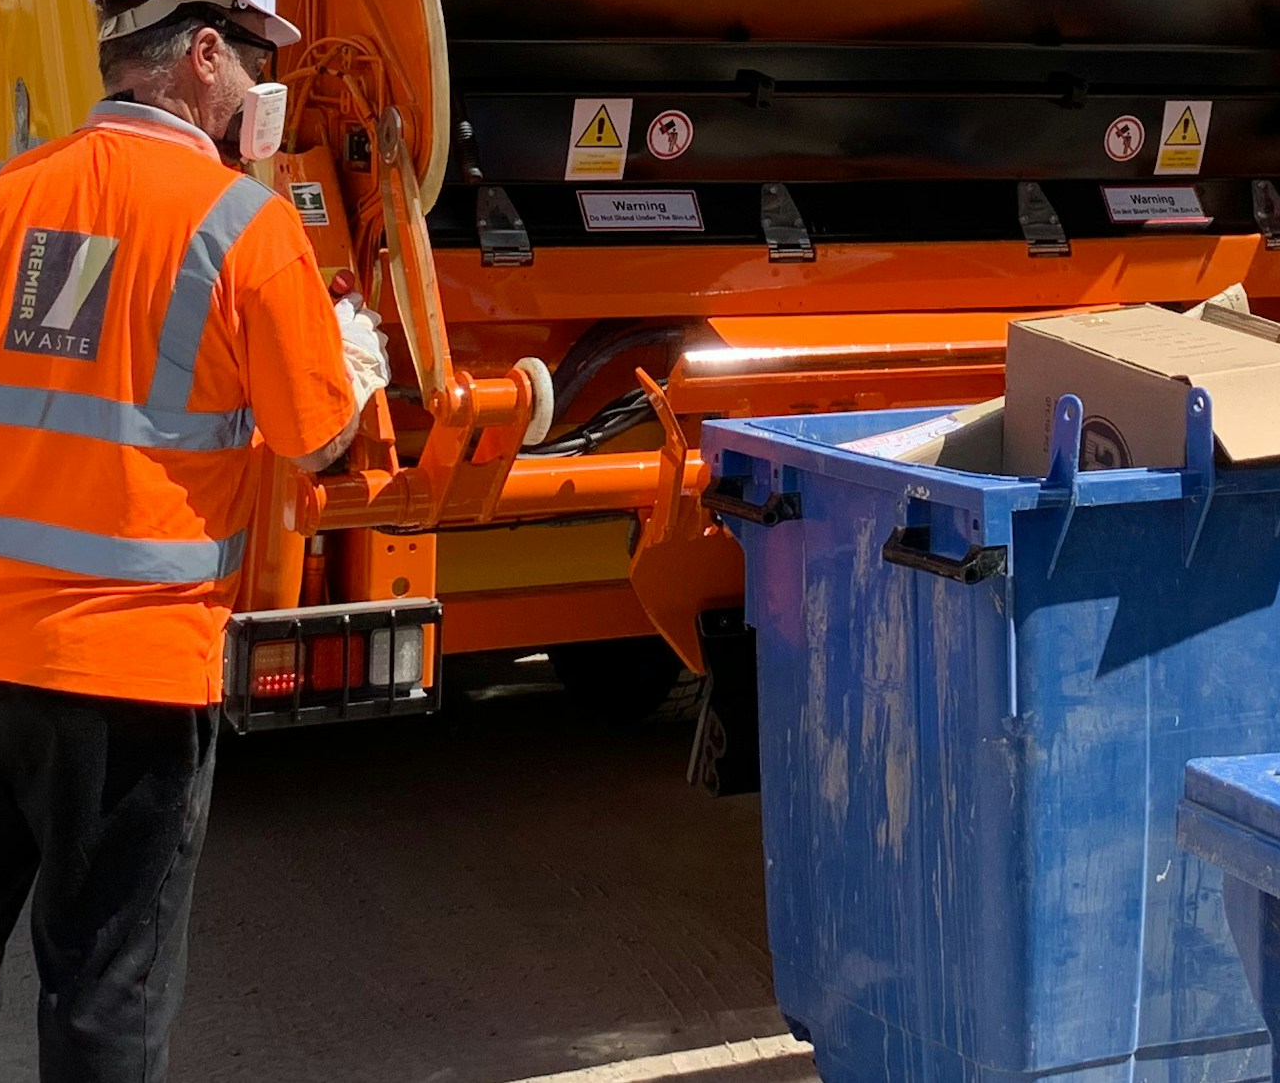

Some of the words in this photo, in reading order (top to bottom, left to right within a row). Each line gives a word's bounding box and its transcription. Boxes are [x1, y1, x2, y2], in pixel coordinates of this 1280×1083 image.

[612, 200, 667, 212] Warning
[1130, 194, 1175, 206] Warning
[20, 232, 47, 319] PREMIER
[14, 329, 90, 355] WASTE
